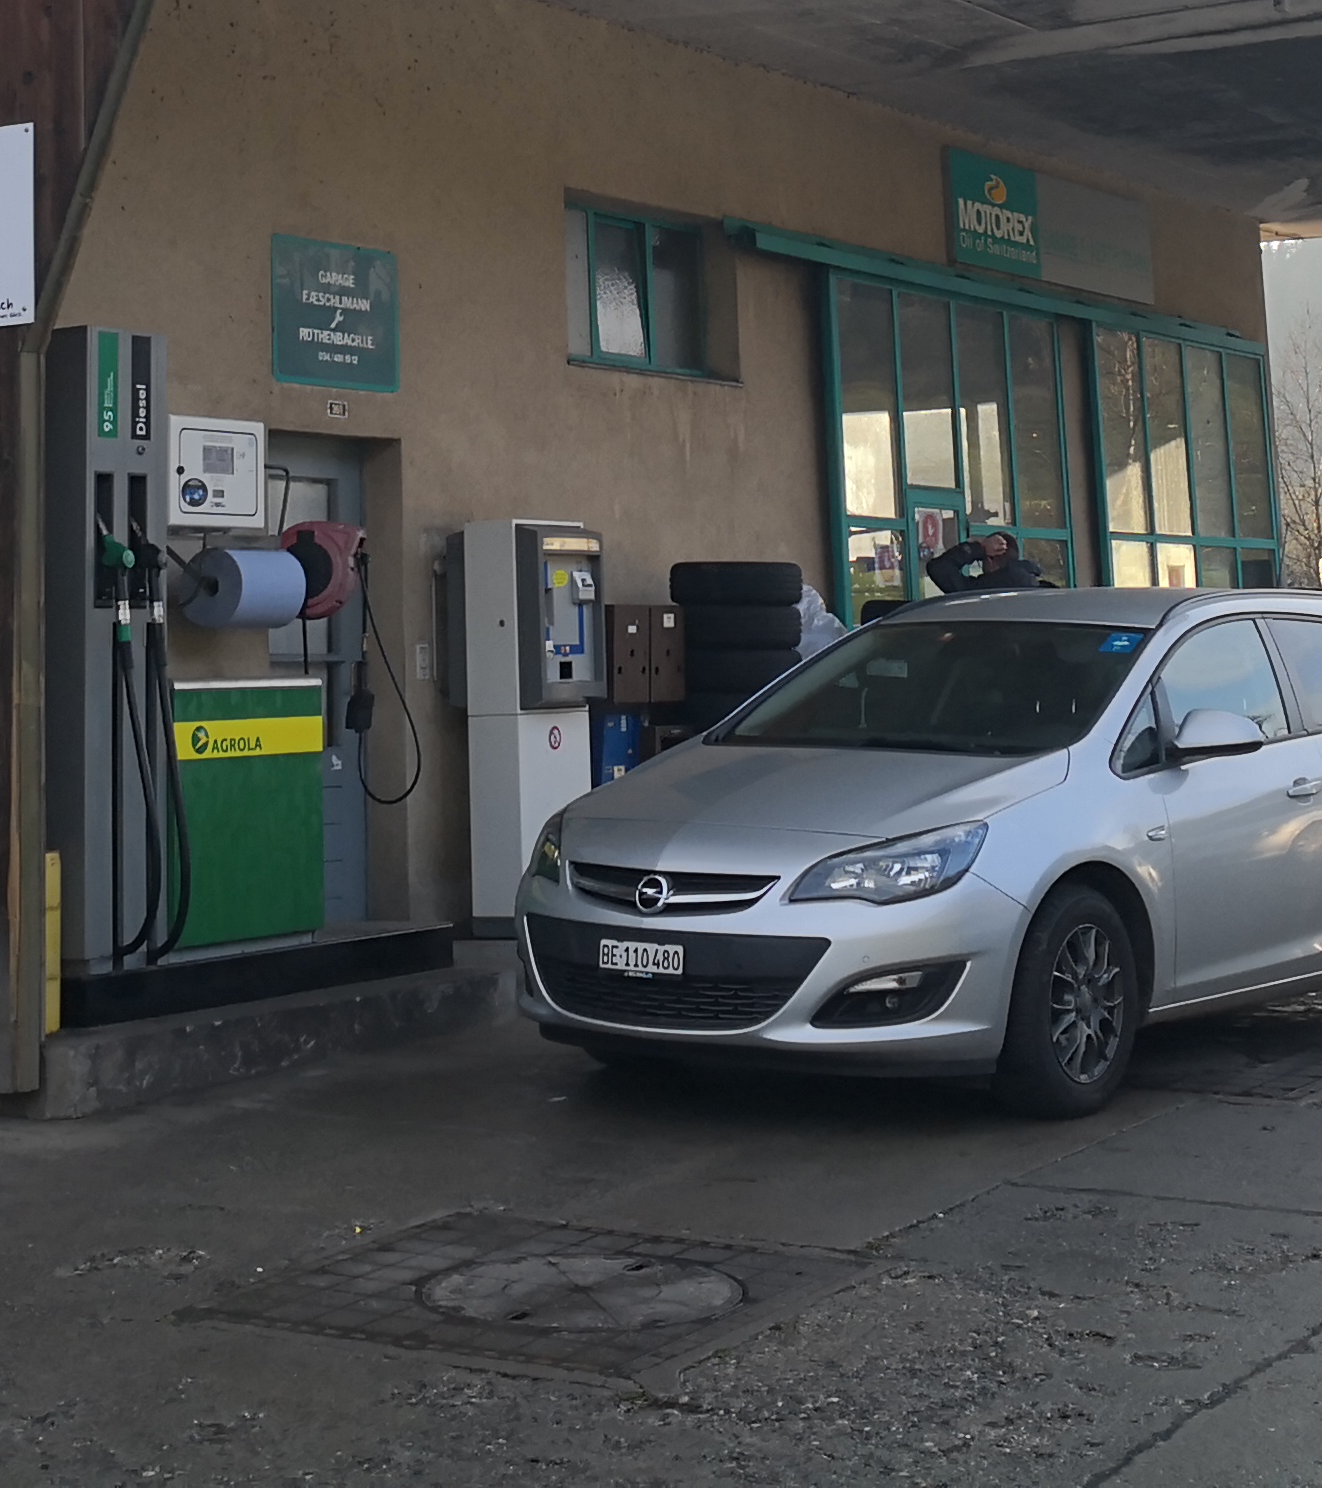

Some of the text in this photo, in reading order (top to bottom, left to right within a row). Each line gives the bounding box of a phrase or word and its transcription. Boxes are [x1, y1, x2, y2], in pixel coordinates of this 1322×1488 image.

[957, 197, 1035, 246] MOTOREX
[318, 270, 355, 288] GARAGE
[136, 384, 147, 435] Diesel
[103, 410, 114, 432] 95
[211, 736, 263, 754] AGROLA
